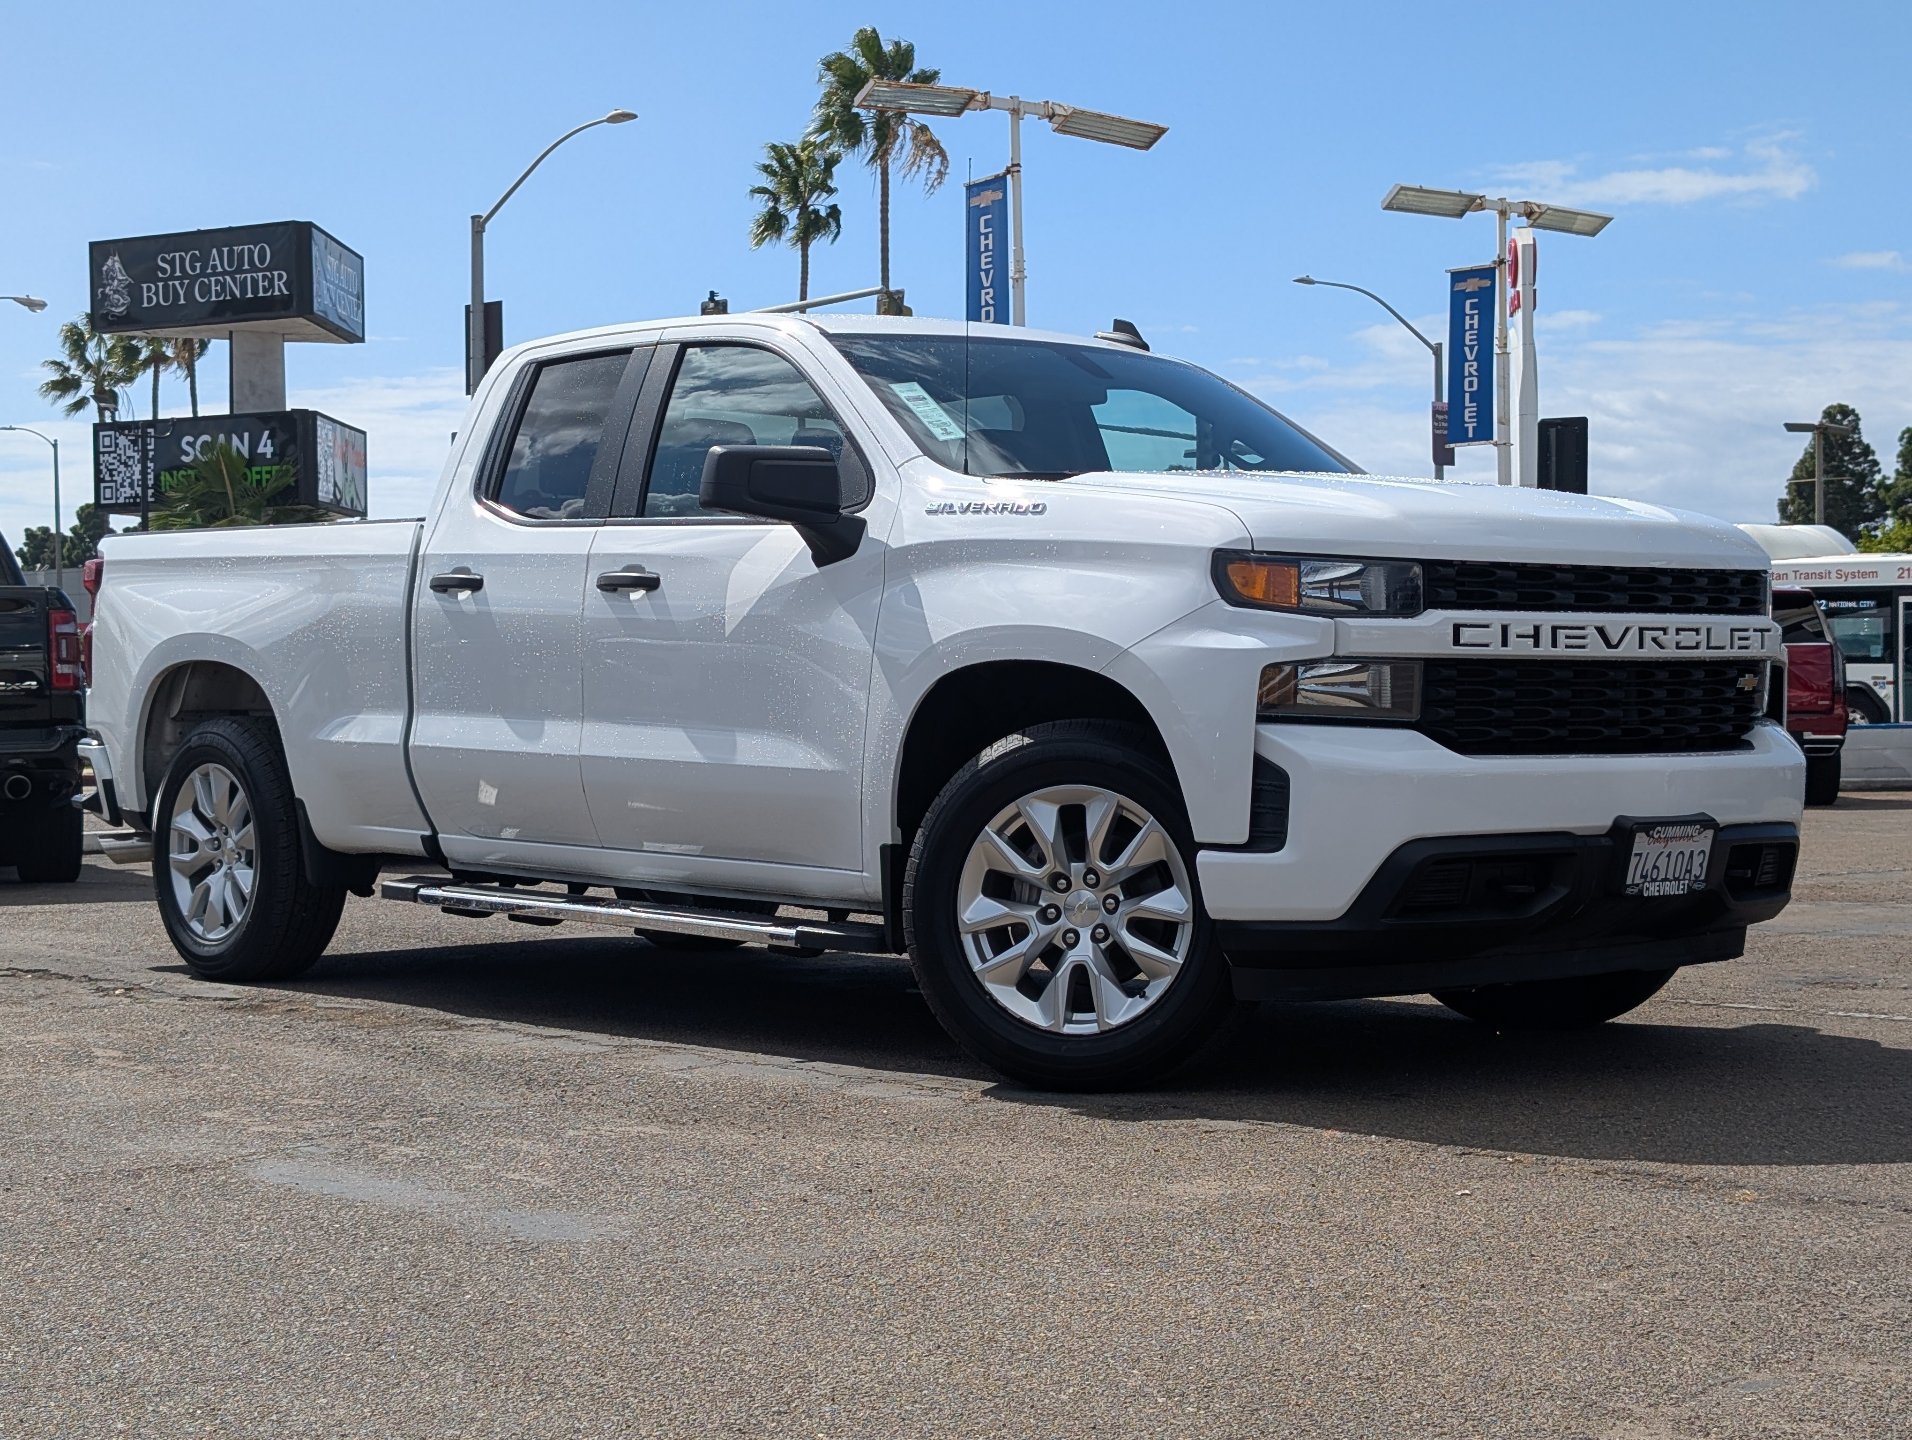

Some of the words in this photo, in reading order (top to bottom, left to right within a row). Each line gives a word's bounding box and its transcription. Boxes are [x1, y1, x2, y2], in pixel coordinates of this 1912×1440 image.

[156, 250, 200, 278] STG
[207, 243, 271, 273] AUTO
[141, 279, 187, 308] BUY
[194, 270, 290, 303] CENTER
[1463, 298, 1479, 438] CHEVROLET
[256, 430, 274, 459] 4
[925, 501, 1048, 516] SILVERADO
[1792, 569, 1832, 580] Transit
[1835, 568, 1879, 582] System
[1897, 567, 1912, 579] 21
[1452, 622, 1771, 651] CHEVROLET
[1643, 880, 1689, 897] CHEVROLET
